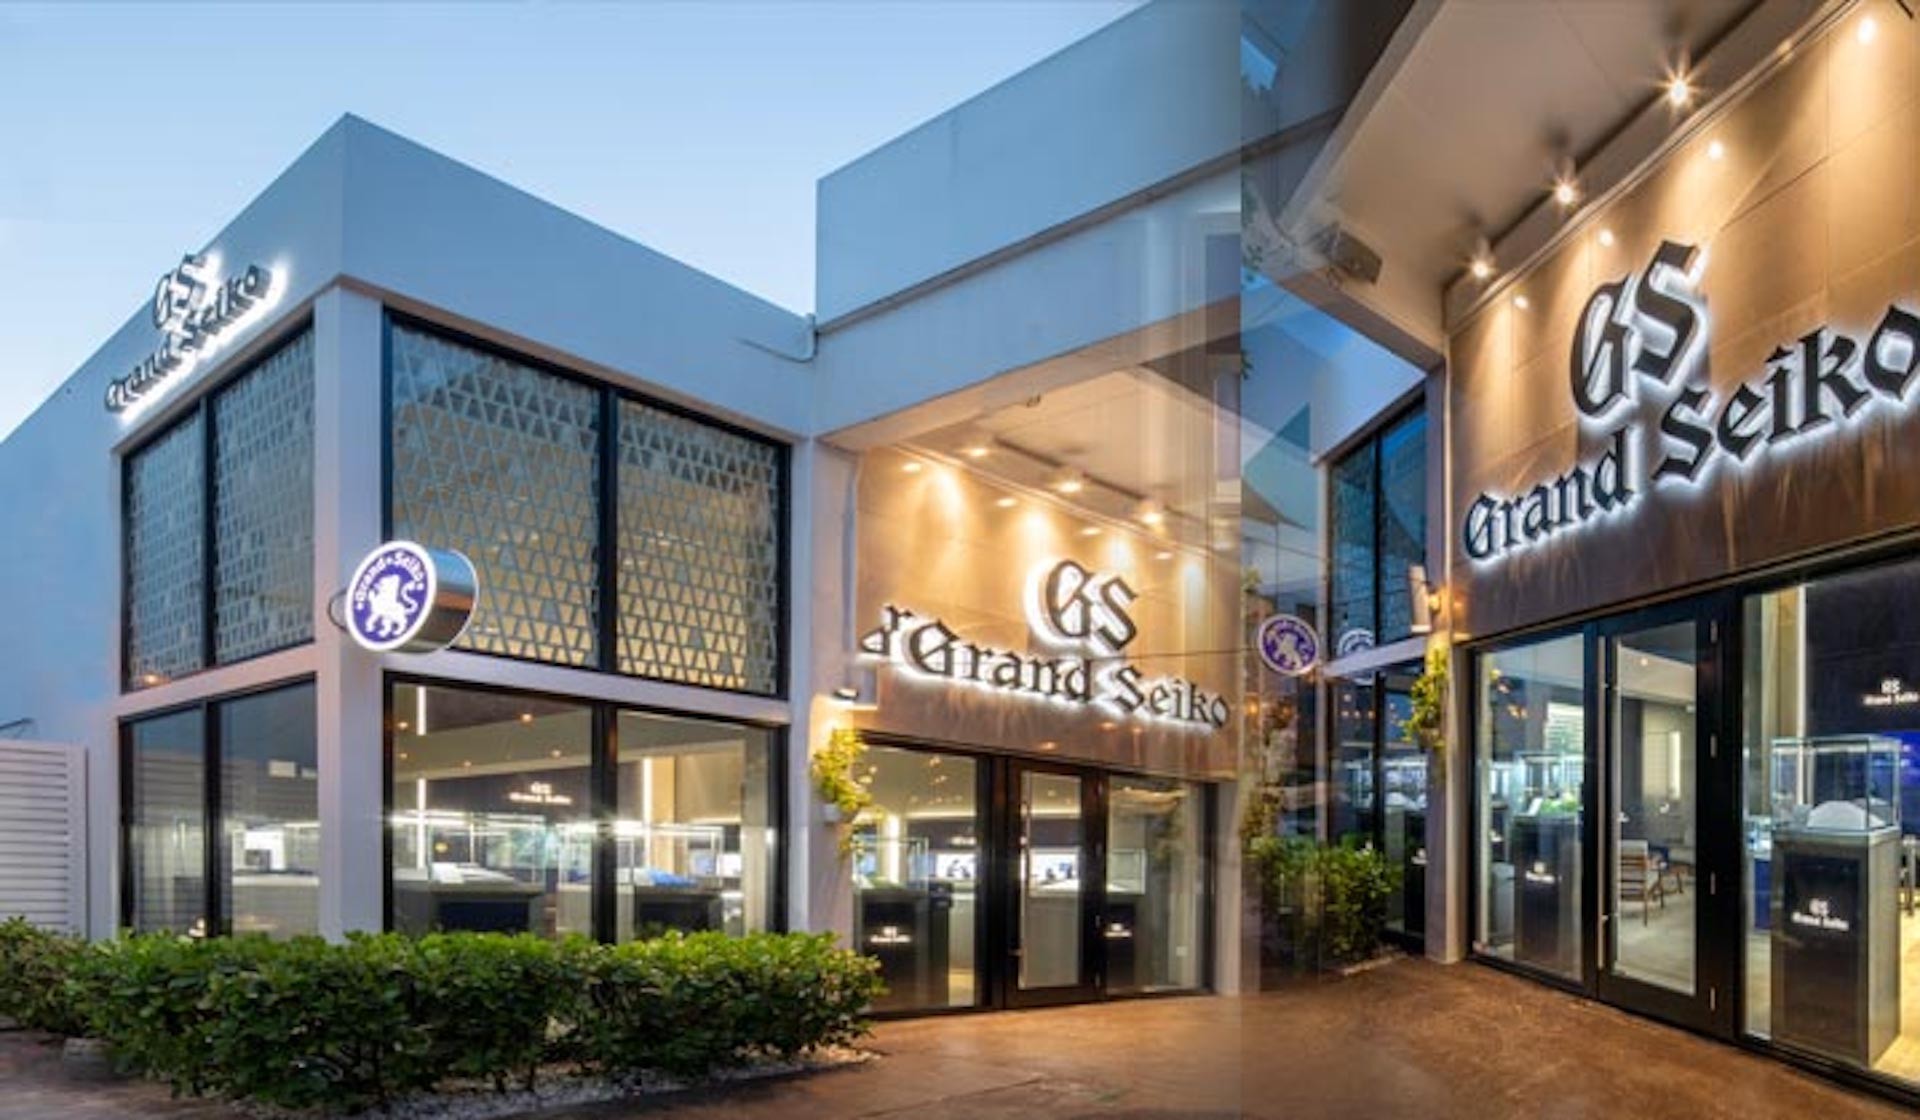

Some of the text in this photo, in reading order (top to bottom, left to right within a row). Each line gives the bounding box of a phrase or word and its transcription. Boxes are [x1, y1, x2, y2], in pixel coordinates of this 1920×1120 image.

[105, 265, 270, 413] Grand Seiko
[1570, 240, 1700, 415] GS
[1463, 304, 1920, 560] Grand Seiko
[908, 619, 1095, 703] Grand
[1114, 664, 1231, 728] Seiko
[1046, 559, 1138, 651] GS
